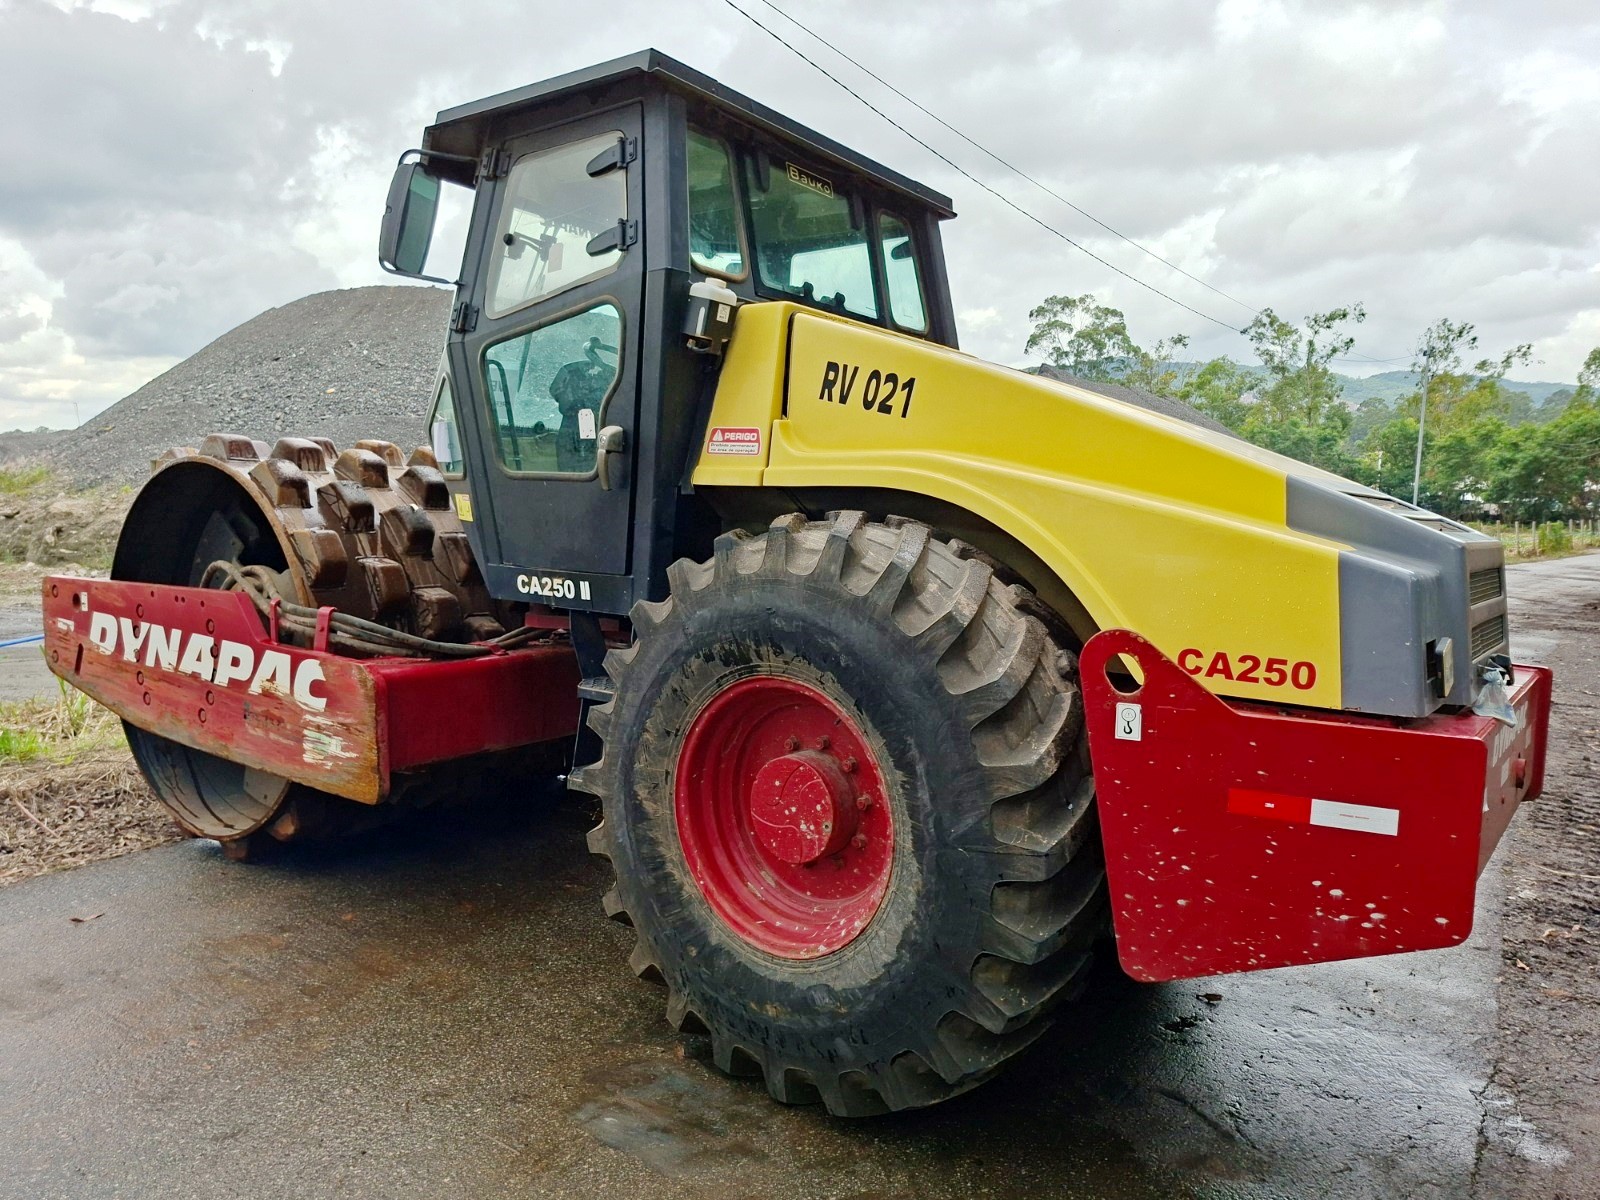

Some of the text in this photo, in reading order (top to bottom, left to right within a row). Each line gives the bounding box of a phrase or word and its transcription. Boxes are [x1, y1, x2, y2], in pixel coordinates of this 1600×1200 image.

[790, 166, 831, 194] Bauko
[819, 361, 916, 418] RV 021
[724, 432, 757, 441] PERIGO
[516, 574, 576, 600] CA250
[89, 611, 328, 713] DYNAPAC
[1177, 648, 1317, 691] CA250
